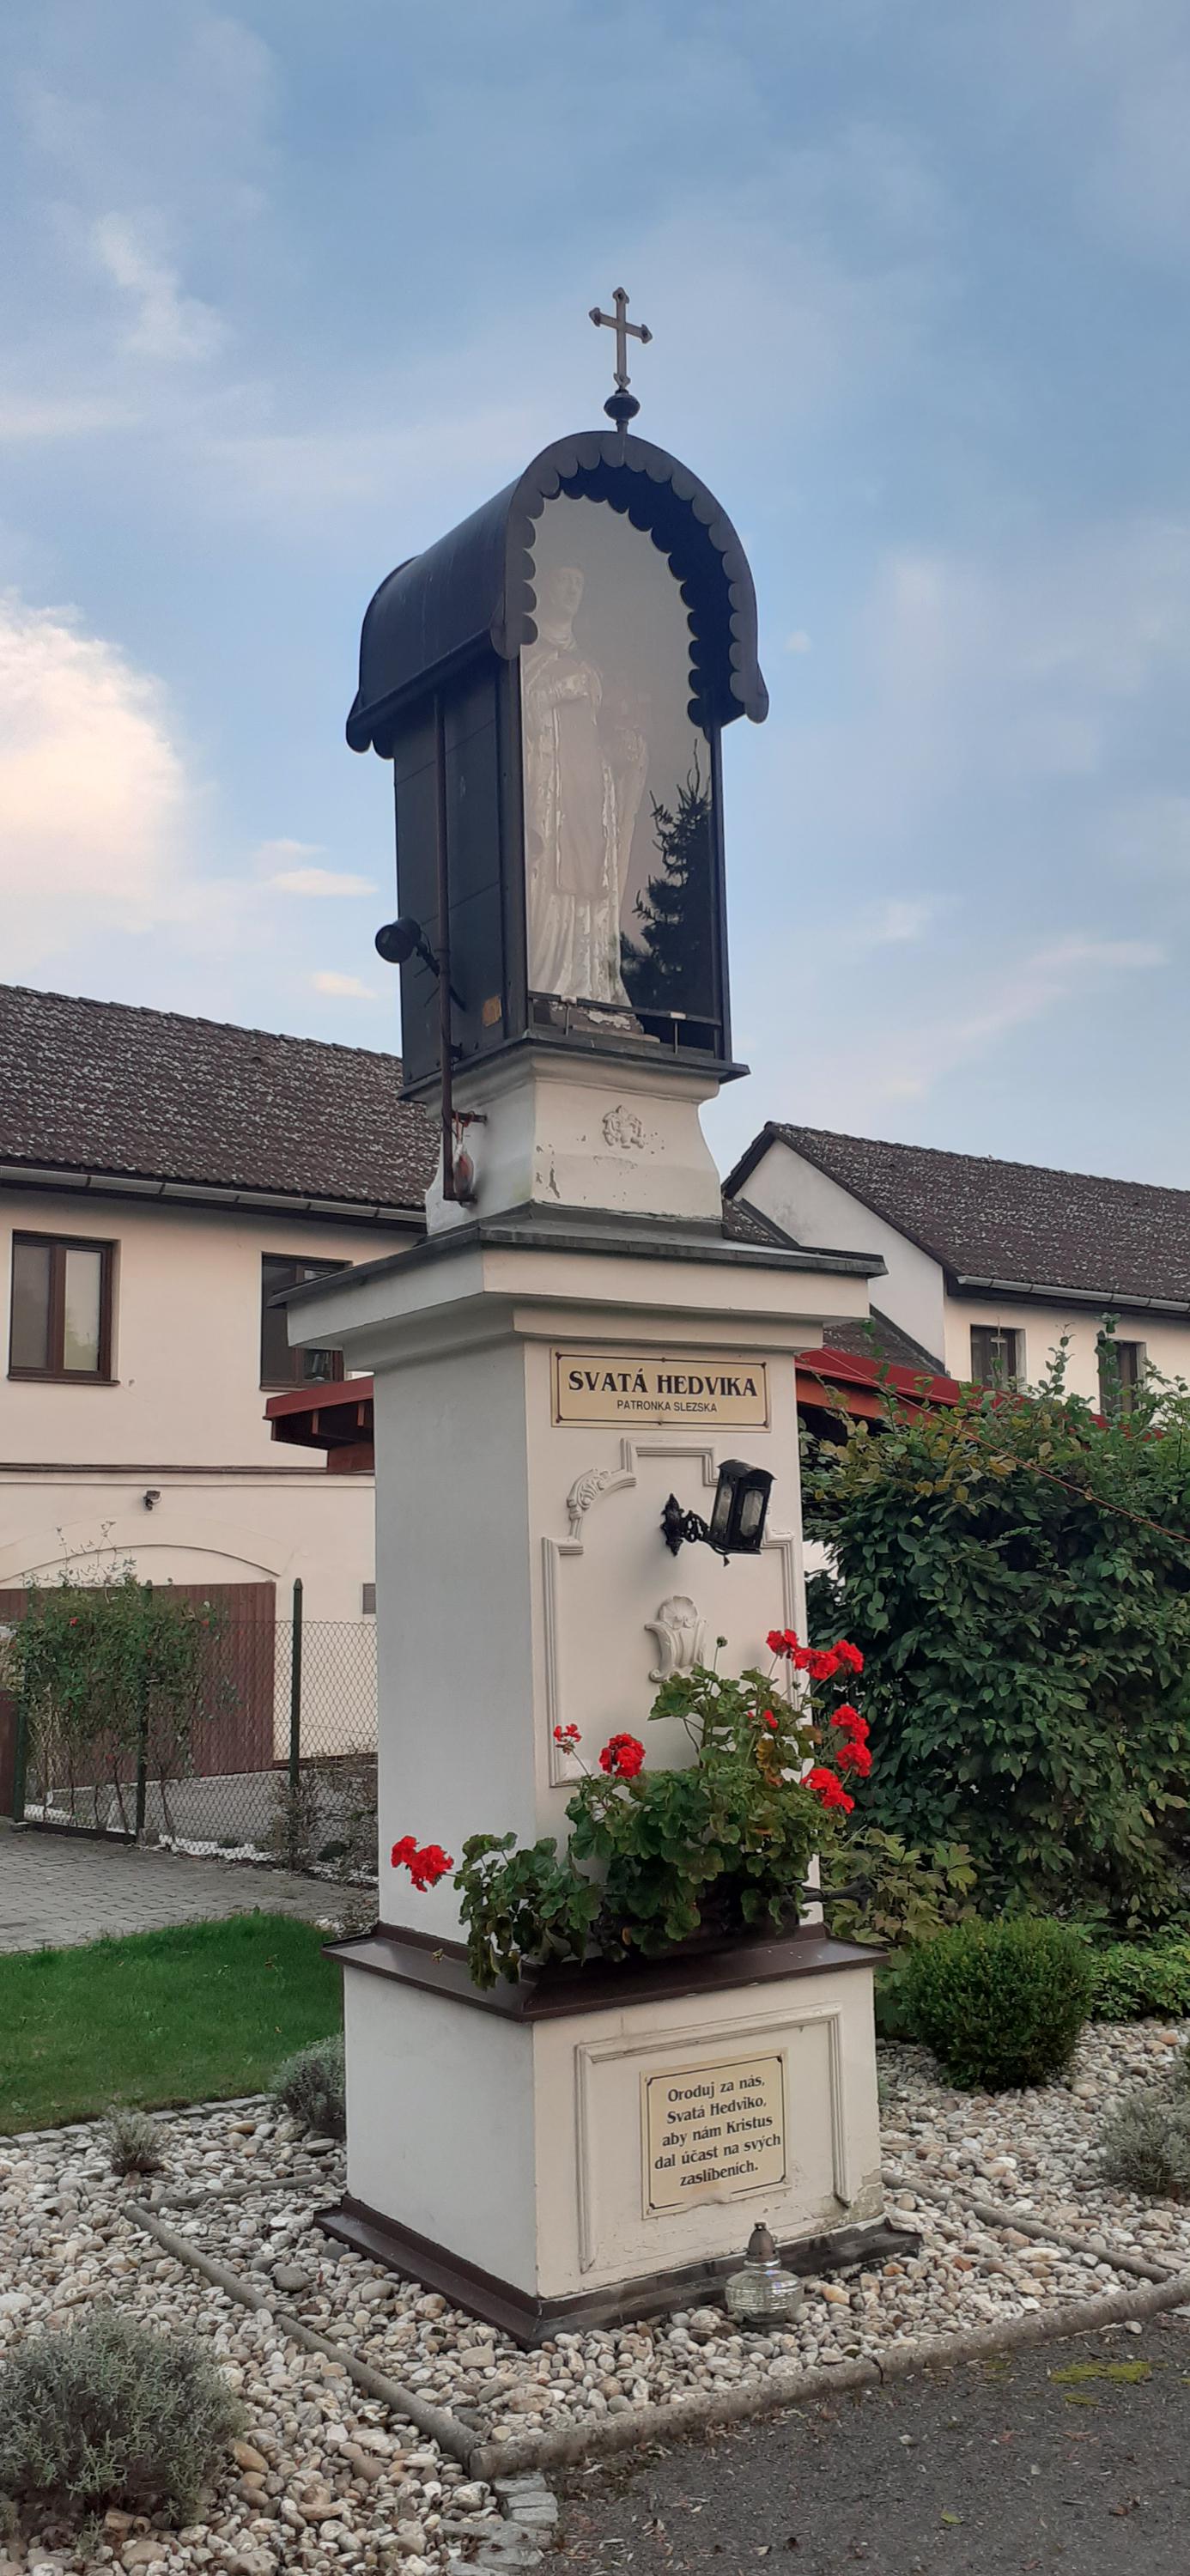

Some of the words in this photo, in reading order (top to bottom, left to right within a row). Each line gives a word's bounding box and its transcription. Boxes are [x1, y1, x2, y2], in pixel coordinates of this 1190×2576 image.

[568, 1368, 648, 1393] SVATÁ
[658, 1375, 757, 1396] HEDVIKA
[617, 1400, 671, 1411] PATRONKA
[674, 1402, 717, 1412] SLEZSKA
[668, 2081, 714, 2102] Oroduj
[720, 2082, 733, 2093] za
[667, 2105, 705, 2123] Svatá
[662, 2133, 688, 2147] aby
[693, 2126, 721, 2141] nám
[726, 2116, 773, 2134] Kristus
[654, 2154, 675, 2169] dal
[682, 2146, 718, 2164] účast
[724, 2145, 739, 2156] na
[744, 2134, 780, 2152] svých
[680, 2160, 758, 2186] zaslíbeních.
